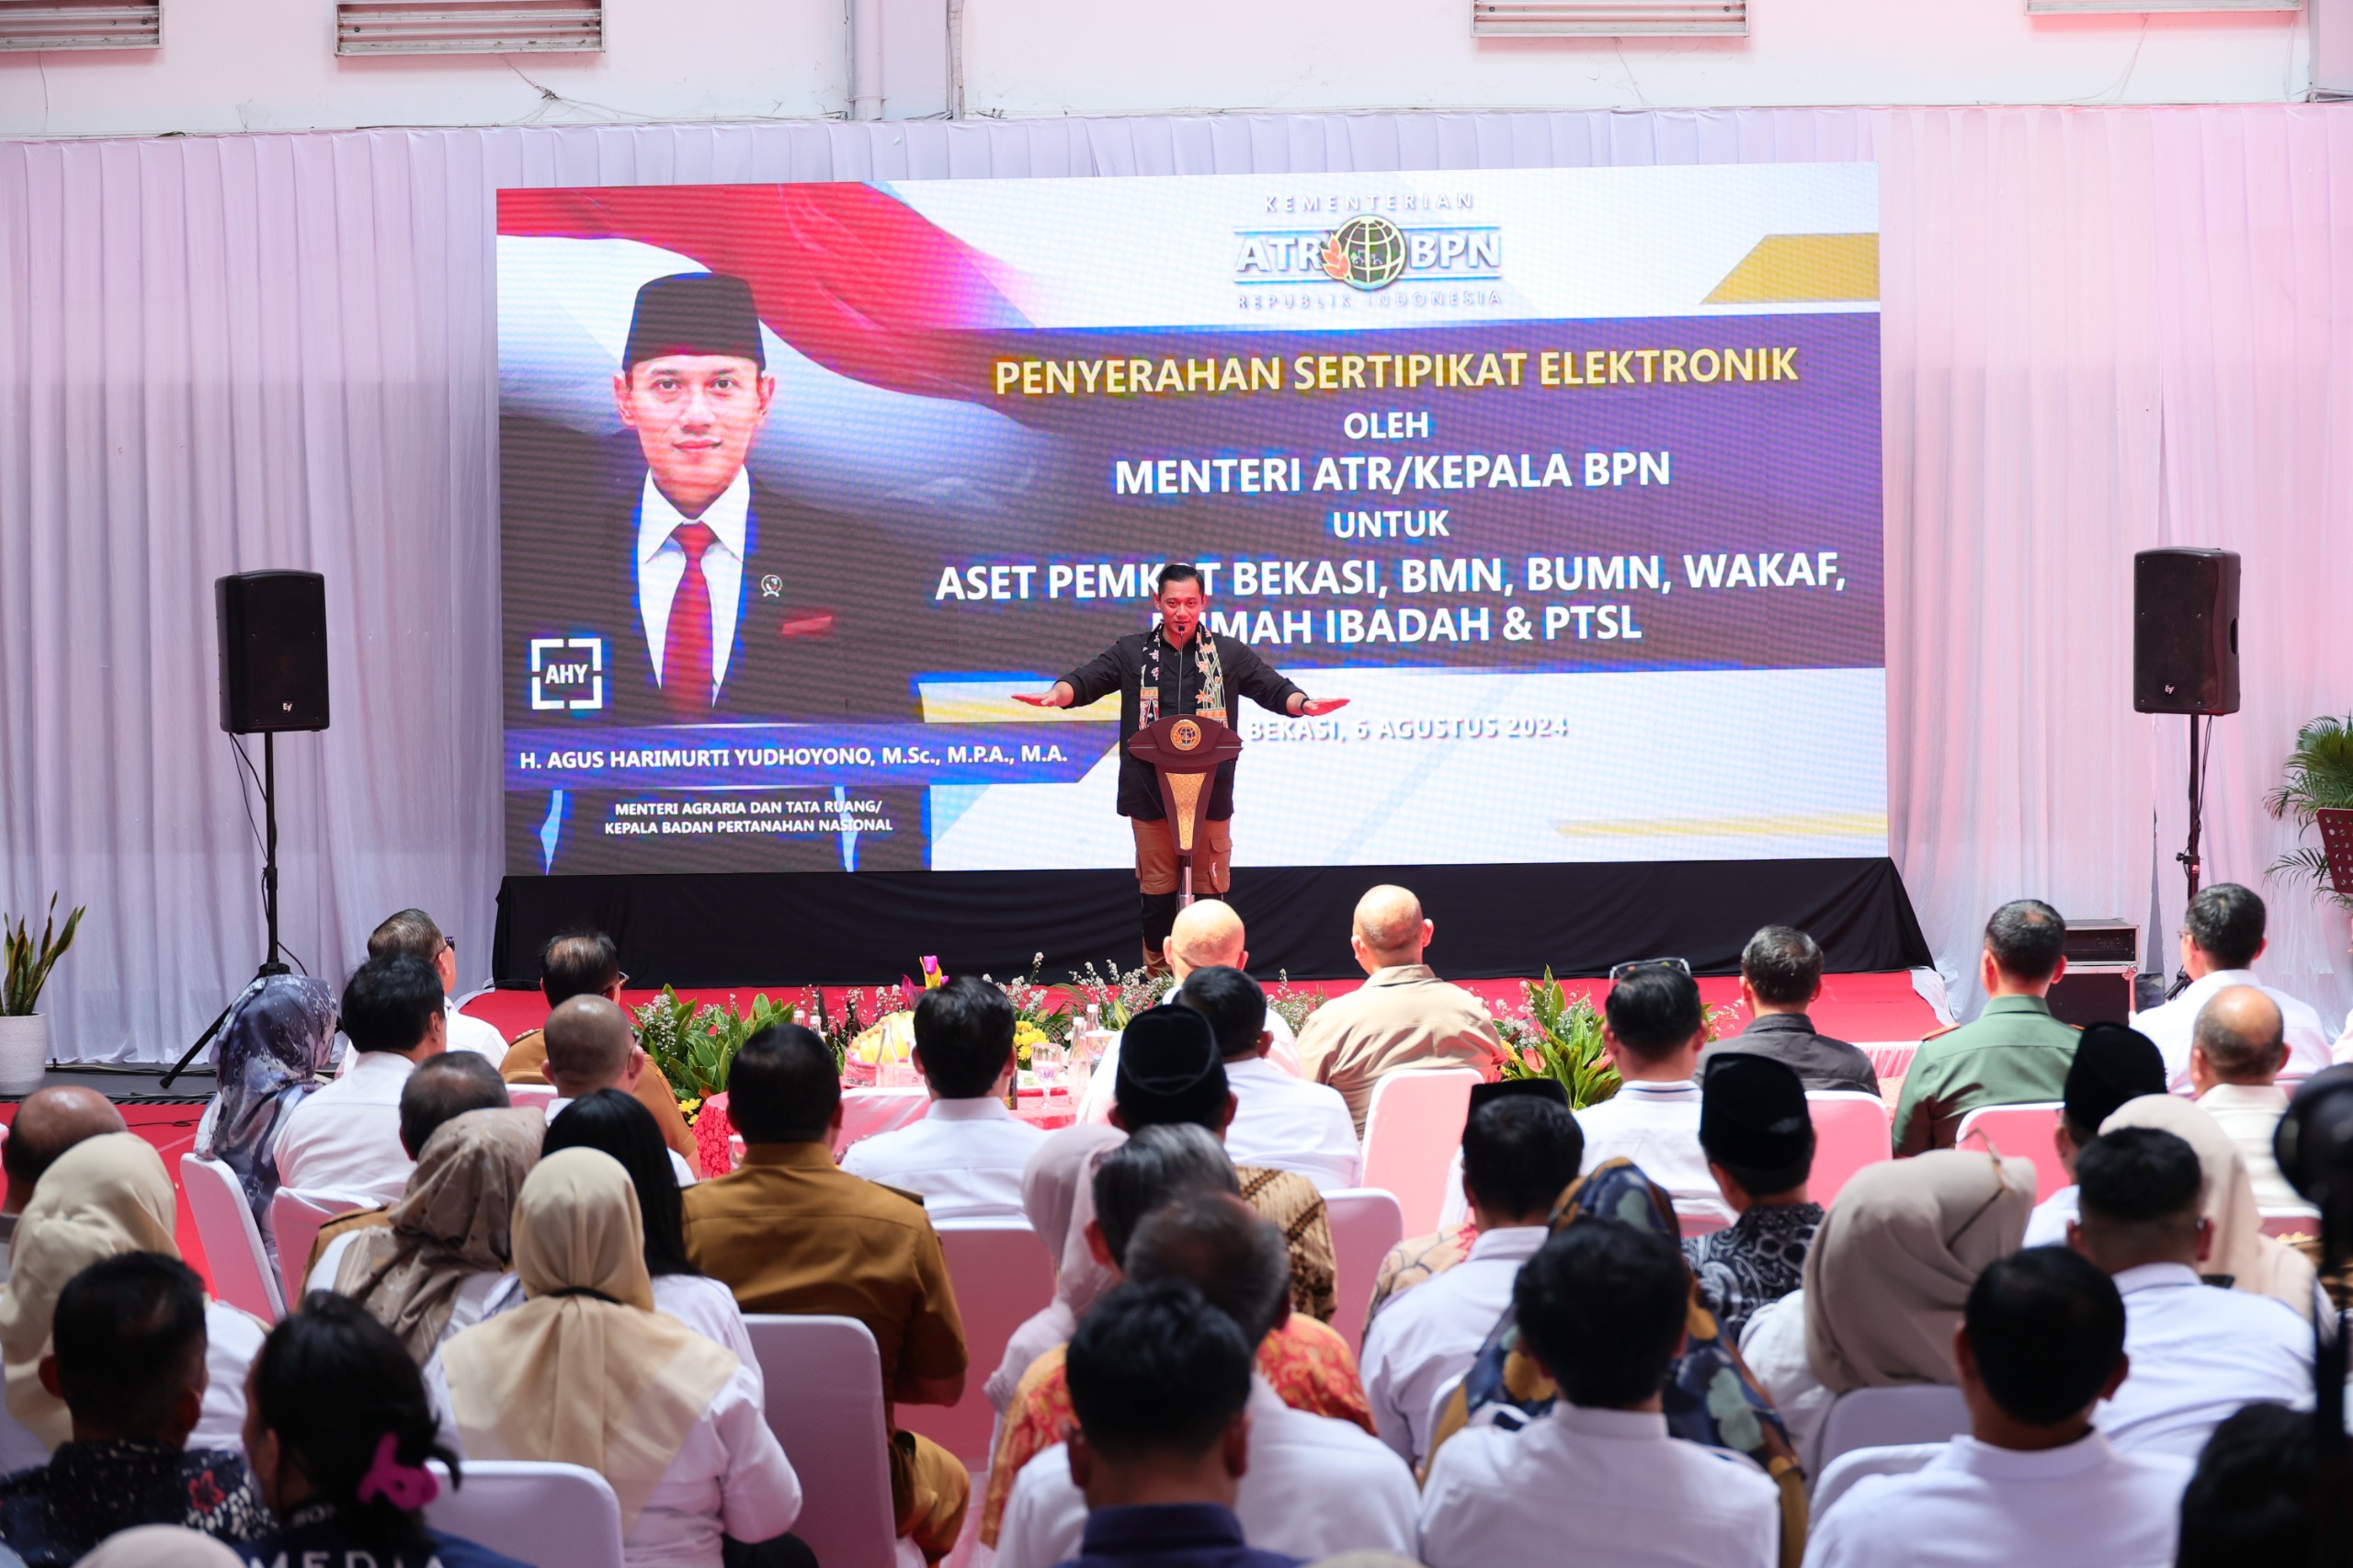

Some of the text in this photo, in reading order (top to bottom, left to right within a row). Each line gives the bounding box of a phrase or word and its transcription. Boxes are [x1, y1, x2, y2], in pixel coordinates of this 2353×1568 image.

[1265, 192, 1472, 212] KEMENTERIAN
[1236, 233, 1500, 272] ATR BPN
[1238, 290, 1501, 310] REPUBLIK INDONESIA
[997, 348, 1798, 393] PENYERAHAN SERTIPIKAT ELEKTRONIK
[1345, 412, 1427, 438] OLEH
[1117, 452, 1669, 494] MENTERI ATR/KEPALA BPN
[1334, 510, 1449, 538] UNTUK
[936, 552, 1845, 599] ASET PEMKT BEKASI, BMN, BUMN, WAKAF,
[1152, 606, 1642, 644] MAH IBADAH & PTSL
[546, 665, 587, 683] AHY
[1249, 715, 1568, 744] BEKASI, 6 AGUSTUS 2024
[521, 745, 1066, 768] H. AGUS HARIMURTI YUDHOYONO, M.Sc., M.P.A., M.A.
[616, 801, 882, 814] MENTERI AGRARIA DAN TATA RUANG/
[606, 819, 892, 834] KEPALA BADAN PERTANAHAN NASIONAL
